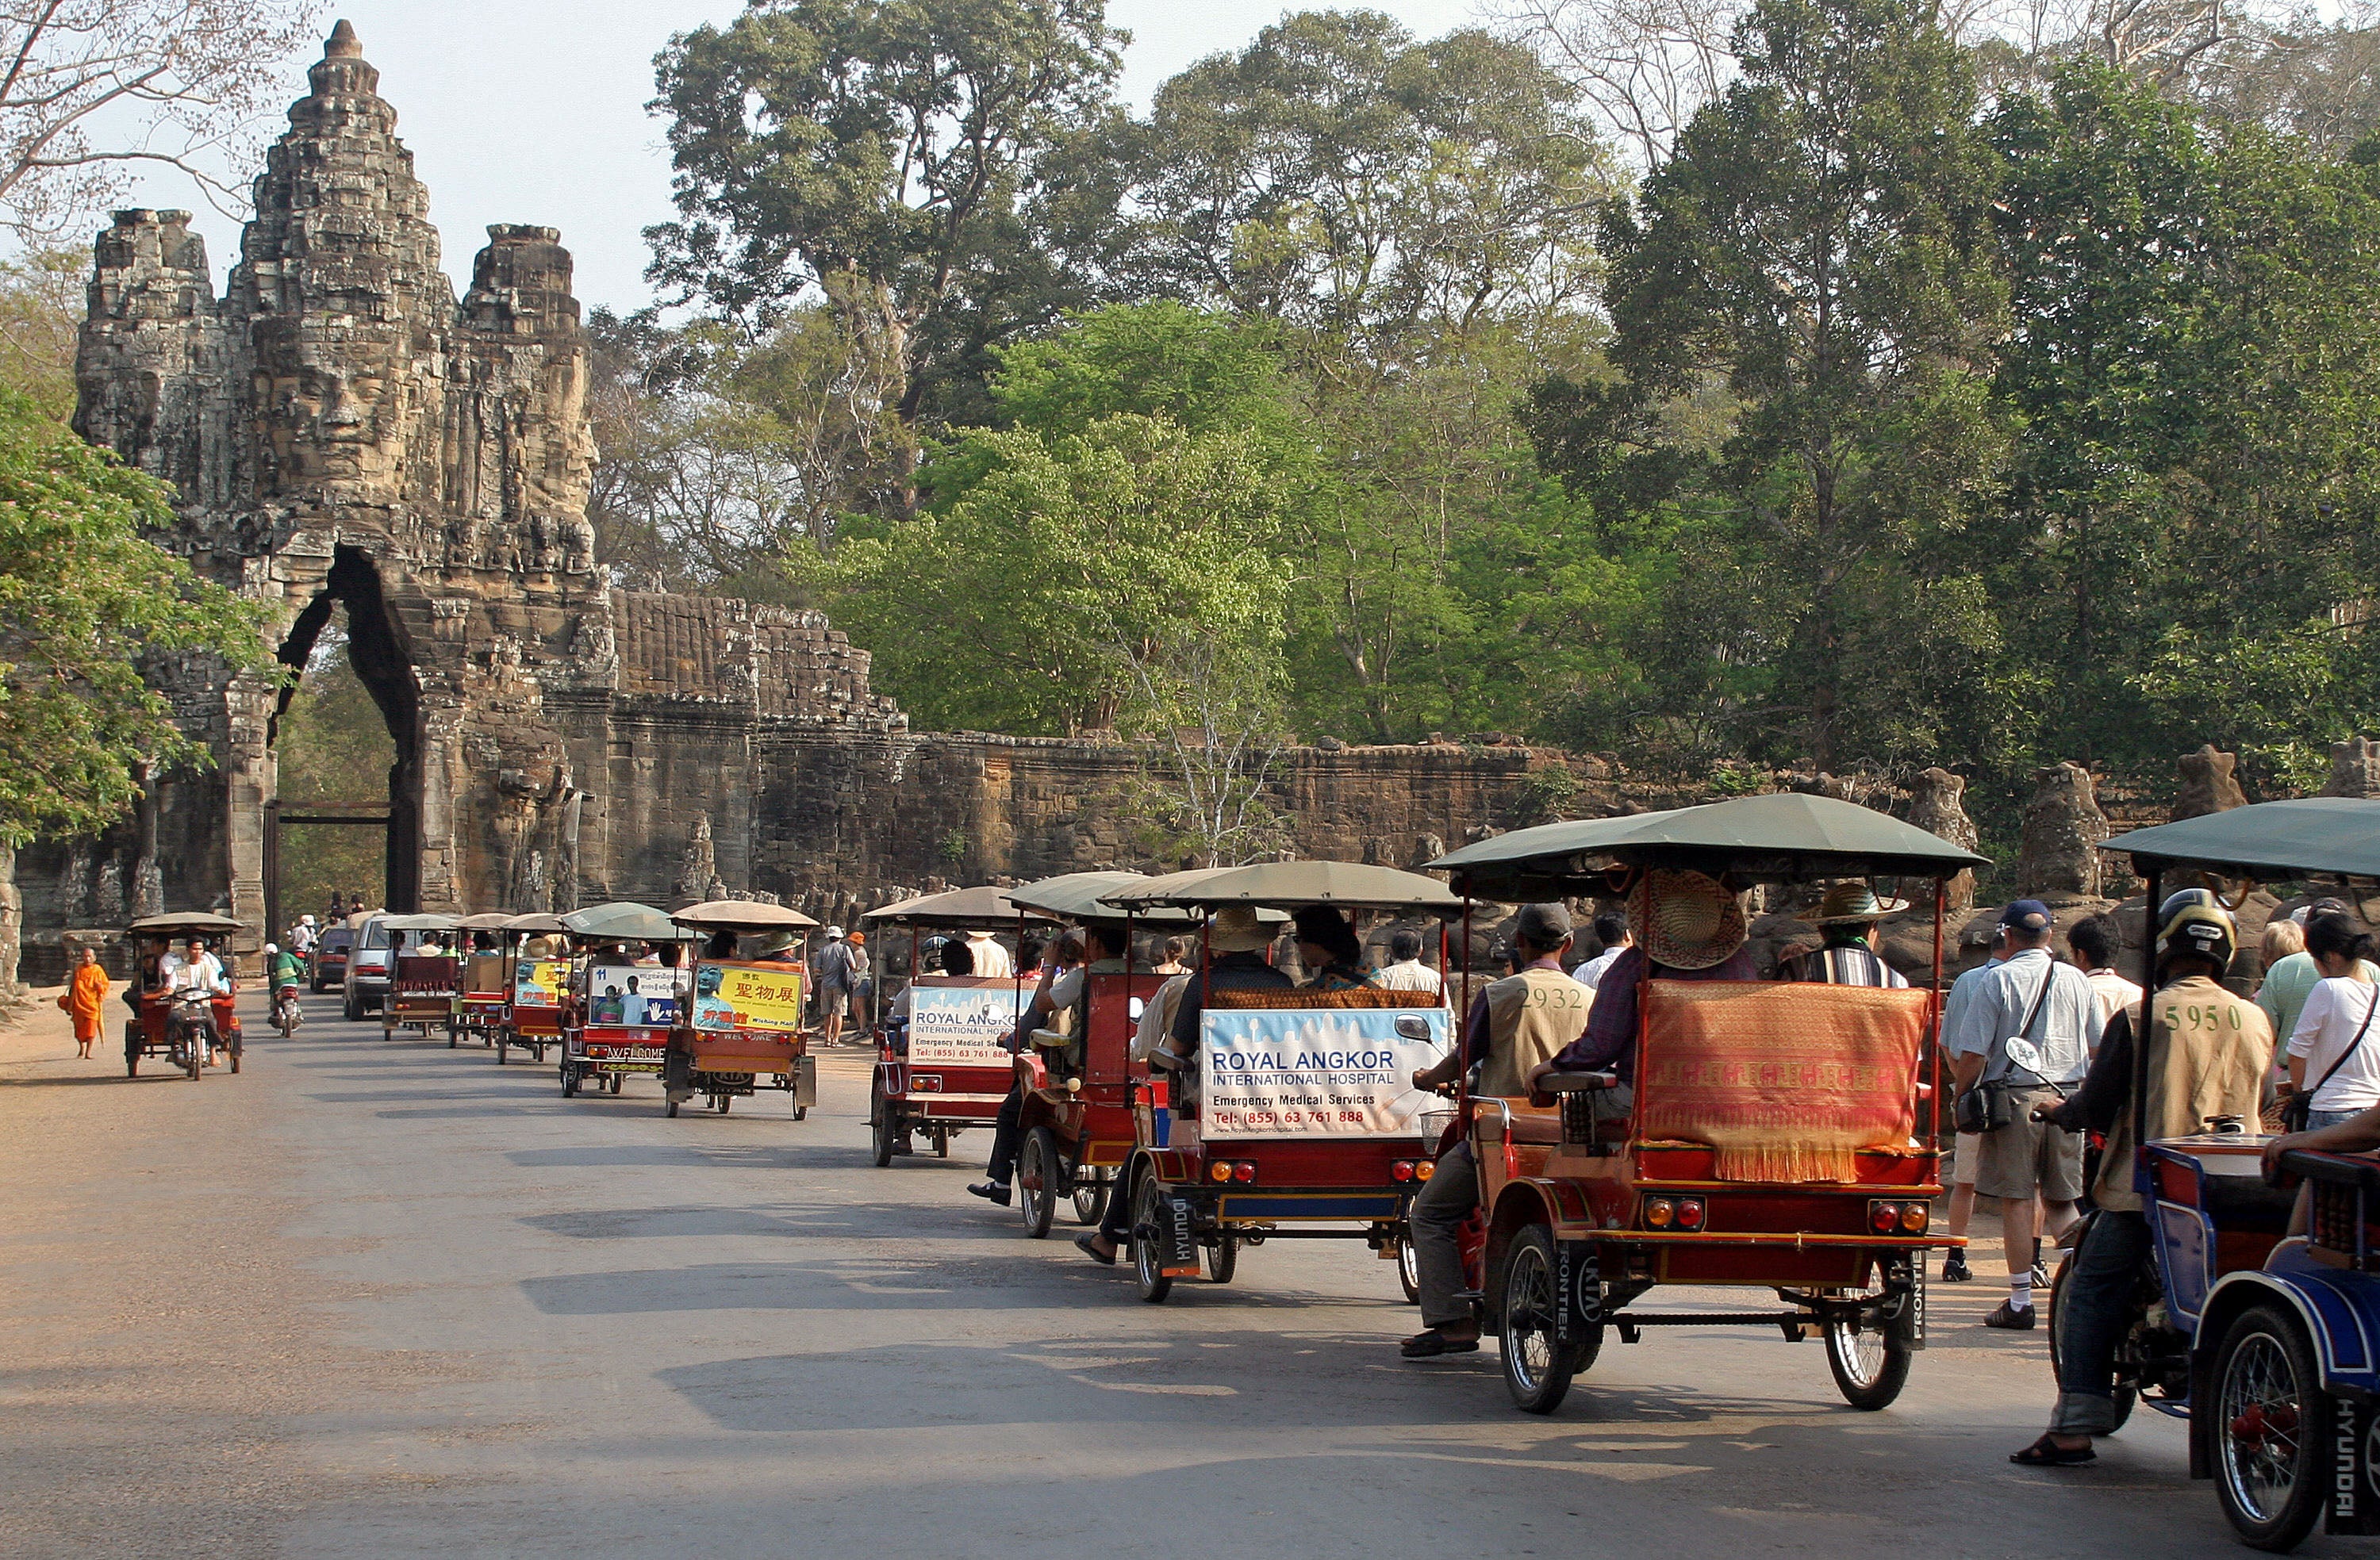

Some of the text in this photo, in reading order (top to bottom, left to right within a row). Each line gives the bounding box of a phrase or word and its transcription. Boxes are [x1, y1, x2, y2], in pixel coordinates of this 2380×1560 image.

[735, 982, 795, 1003] 聖物展
[1517, 987, 1583, 1009] 2932
[916, 1013, 962, 1024] ROYAL
[2165, 1005, 2241, 1031] 5950
[724, 1033, 771, 1041] WELOME
[916, 1025, 983, 1035] INTERNATIONAL
[916, 1038, 953, 1047] Emergency
[934, 1049, 955, 1058] (855)
[1213, 1051, 1395, 1070] ROYAL ANGKOR
[1213, 1072, 1395, 1087] INTERNATIONAL HOSPITAL
[1213, 1094, 1375, 1108] Emergency Medical Services
[1215, 1111, 1364, 1125] Tel: (855) 63 761 888
[1173, 1198, 1190, 1260] HYUNDAI
[1585, 1267, 1601, 1311] KIA
[1912, 1250, 1922, 1340] FRONTIE
[2336, 1398, 2355, 1516] HYUNDAI
